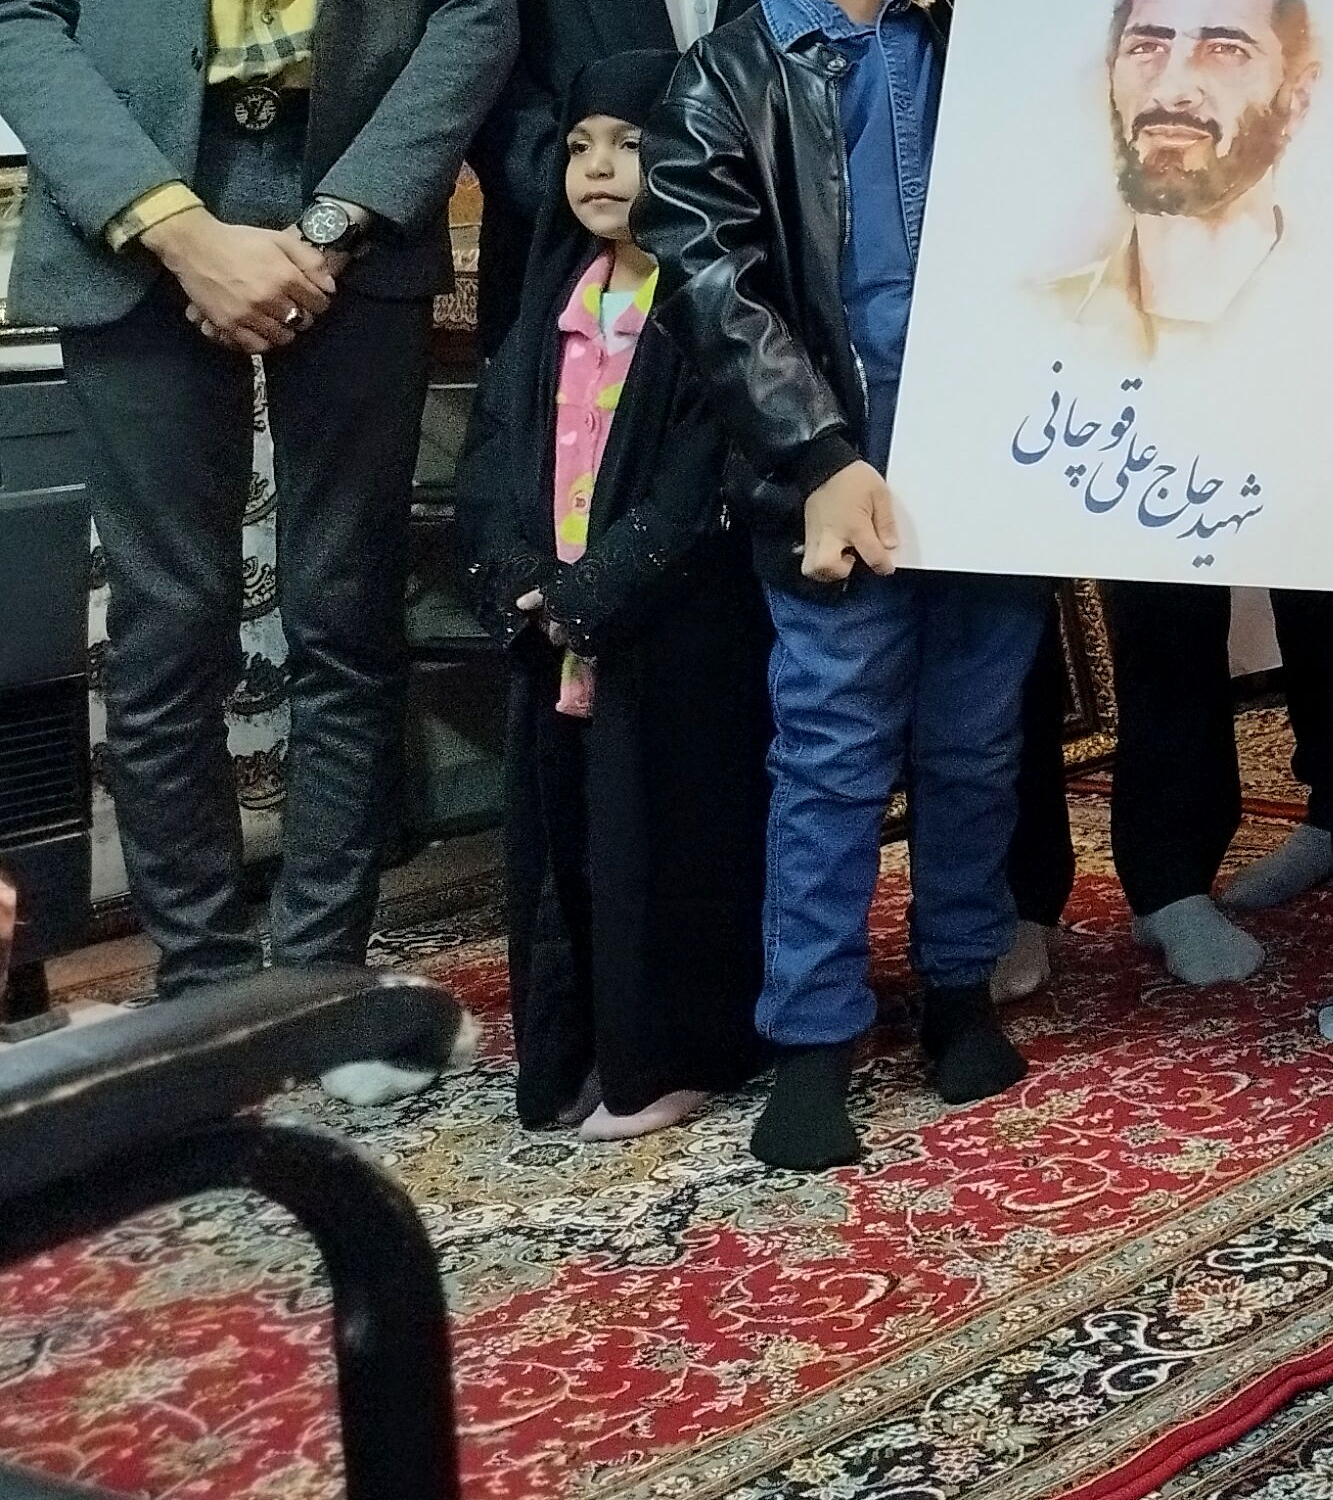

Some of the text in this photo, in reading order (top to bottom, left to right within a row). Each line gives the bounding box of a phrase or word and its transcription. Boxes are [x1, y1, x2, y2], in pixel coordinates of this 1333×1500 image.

[1011, 360, 1264, 569] شهید حاج علی قوچانی
